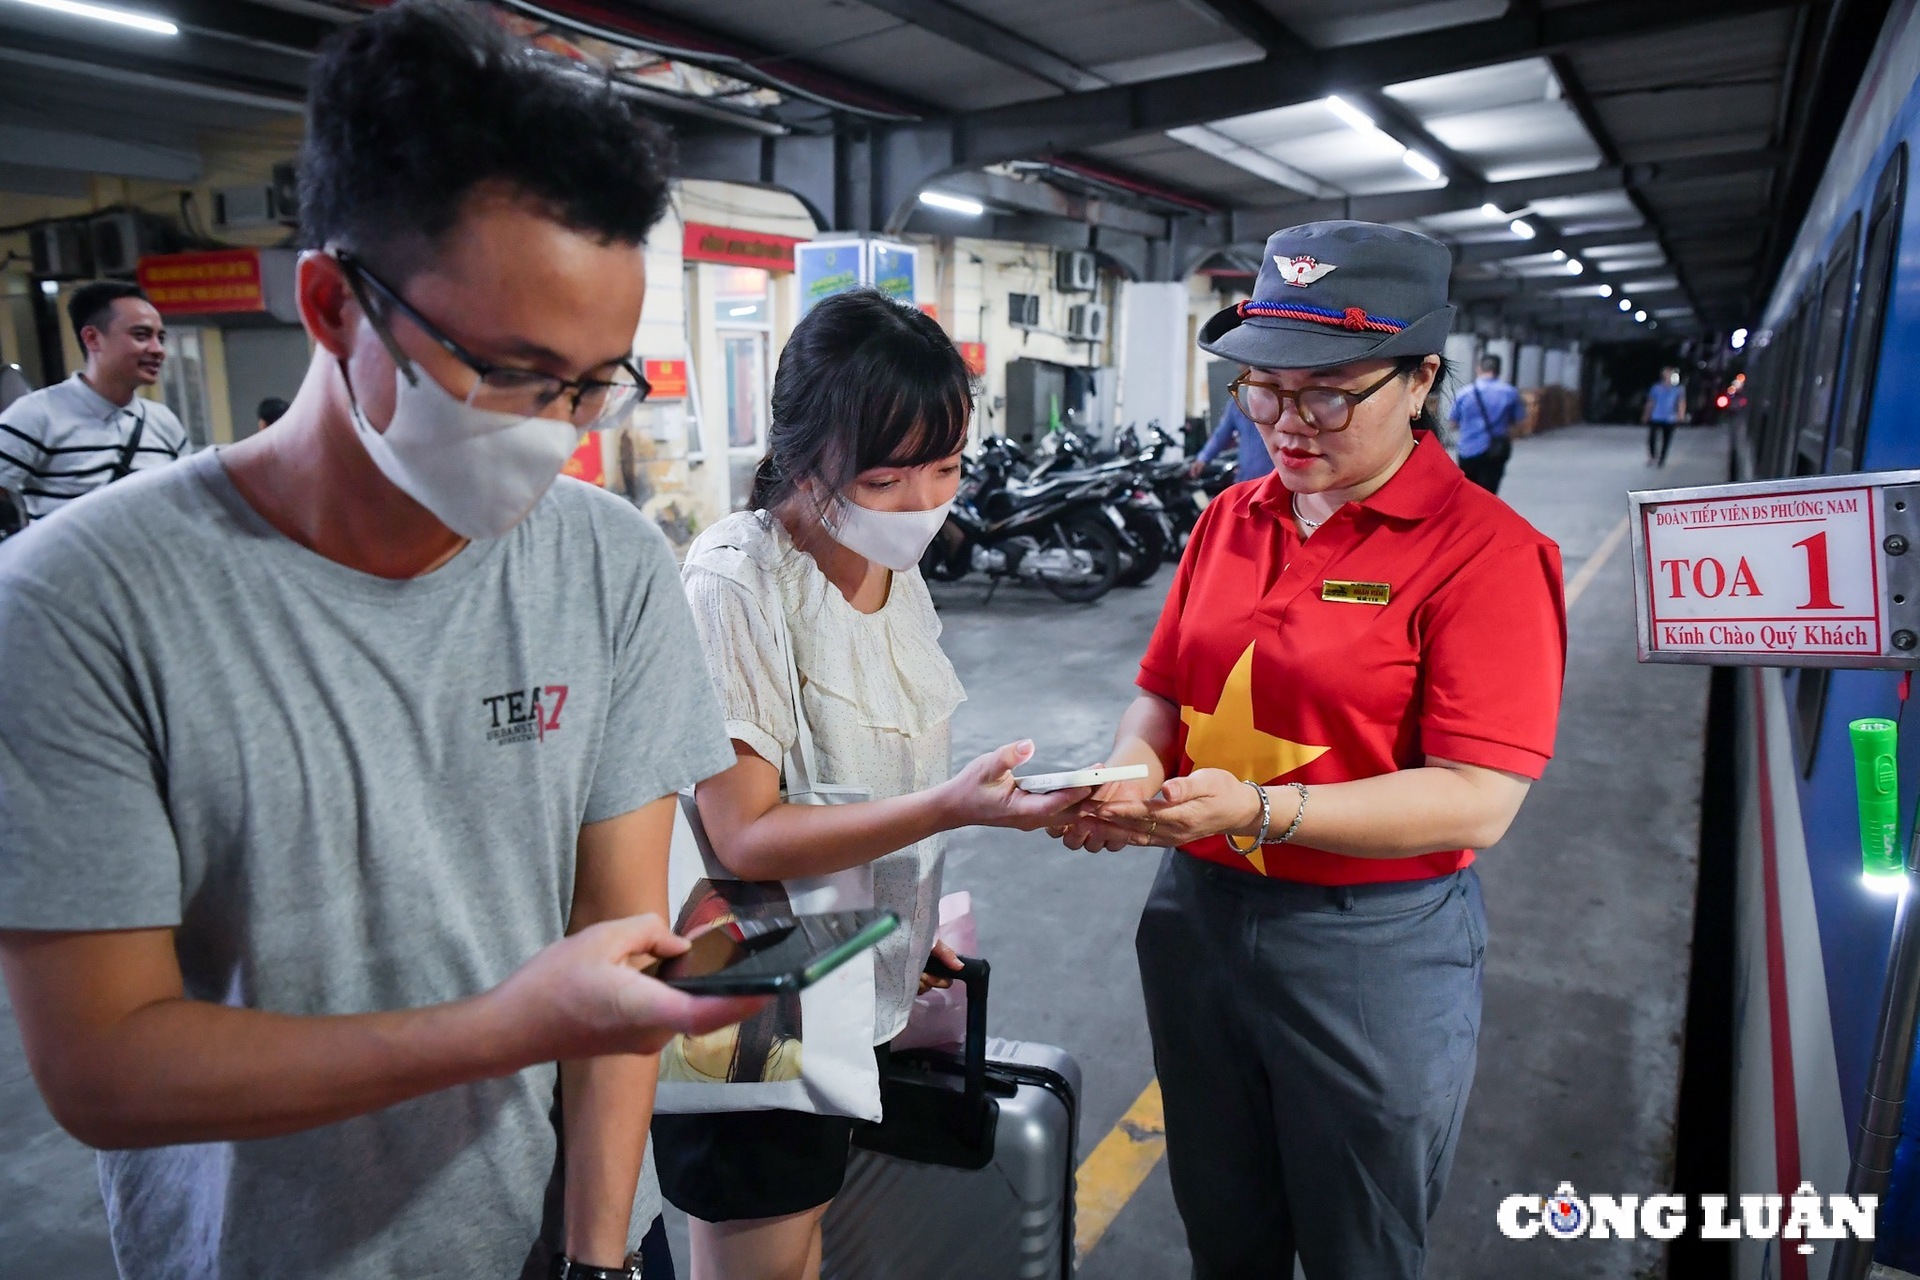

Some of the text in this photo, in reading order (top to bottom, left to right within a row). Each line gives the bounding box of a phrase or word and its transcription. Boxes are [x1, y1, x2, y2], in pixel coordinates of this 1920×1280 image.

[1656, 498, 1858, 526] ĐOÀN TIẾP VIÊN ĐS PHƯƠNG NAM
[1660, 531, 1845, 610] TOA 1
[1664, 625, 1868, 650] Kính Chào Quý Khách
